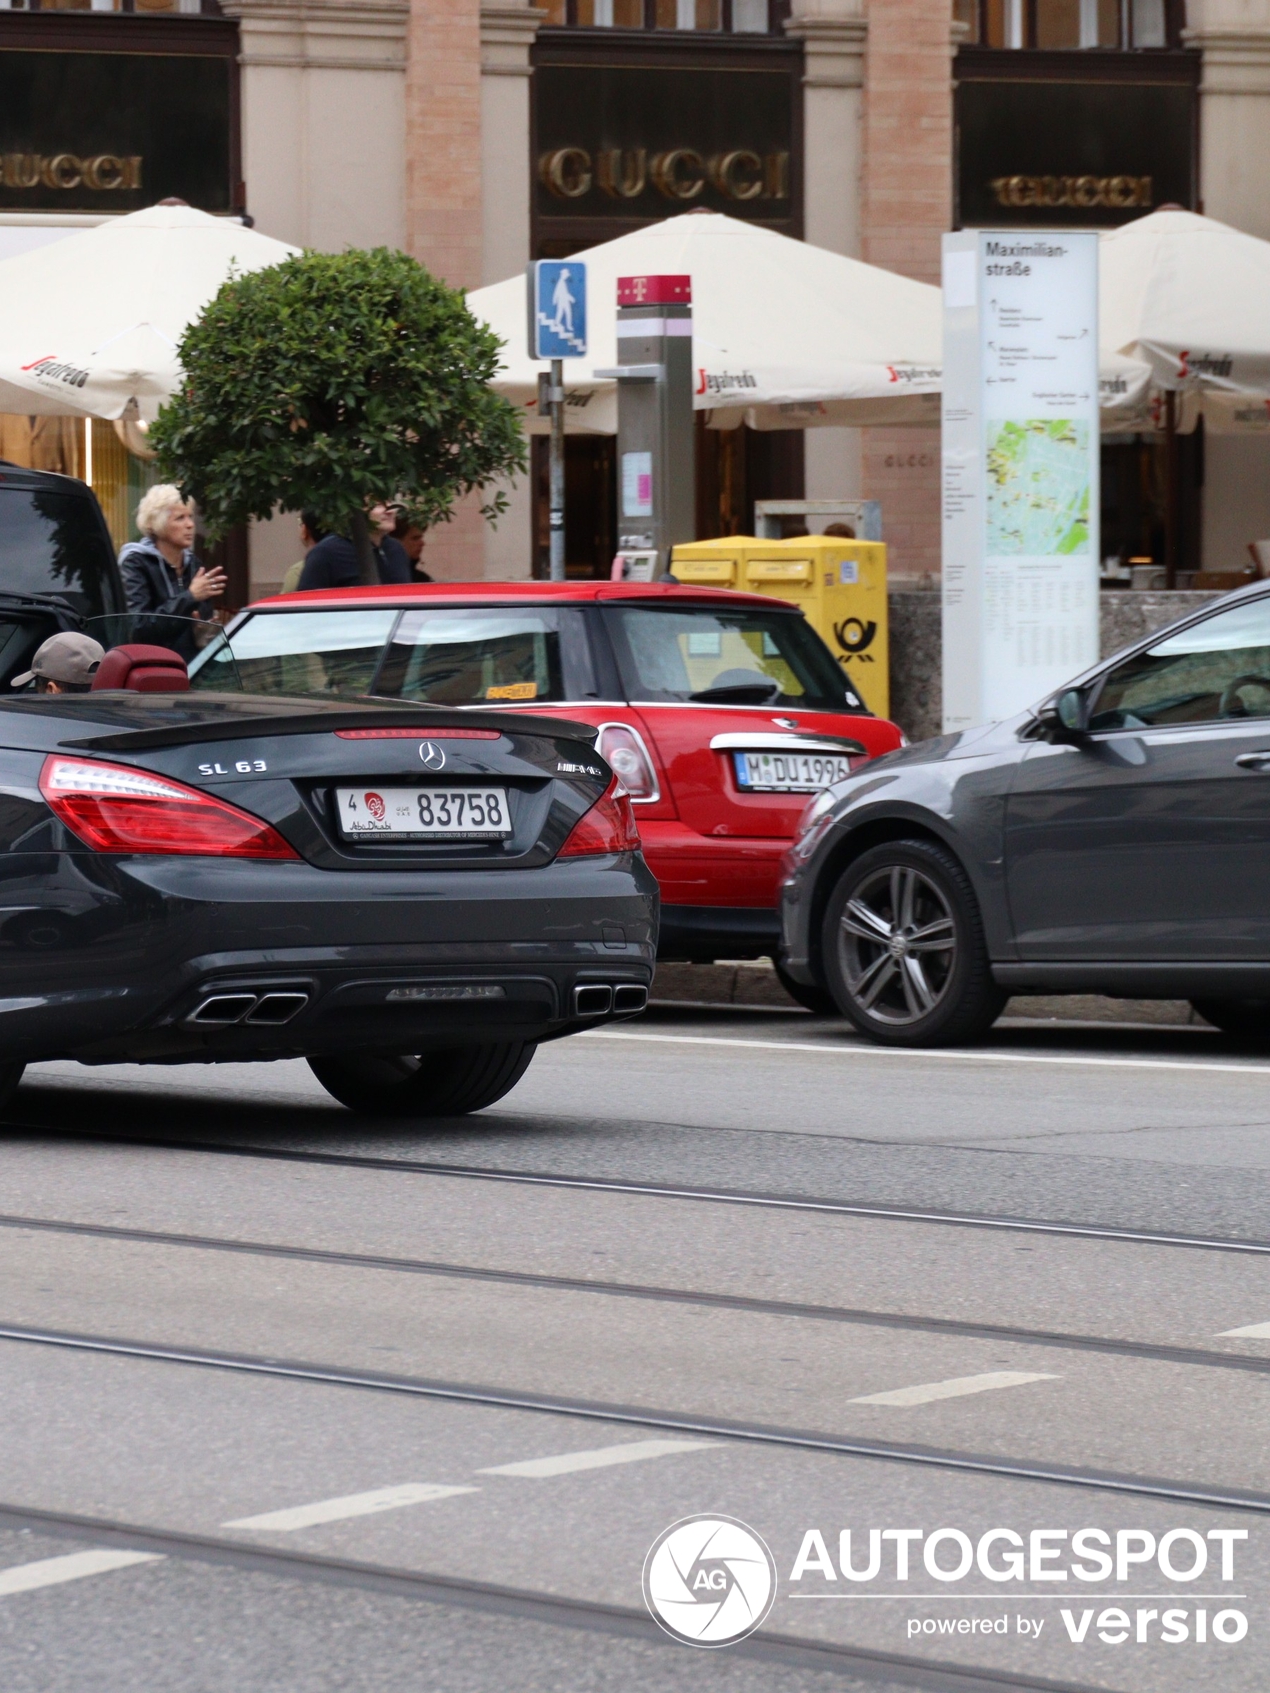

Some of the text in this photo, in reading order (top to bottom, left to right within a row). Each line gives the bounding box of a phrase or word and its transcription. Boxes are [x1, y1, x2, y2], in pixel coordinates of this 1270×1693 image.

[538, 147, 788, 199] GUCCI
[994, 175, 1151, 207] GUCCI
[986, 242, 1068, 257] Maximilian-
[986, 261, 1031, 276] straße
[20, 355, 90, 389] Segafredo
[198, 760, 267, 776] SL 63
[747, 757, 848, 784] M DU 1996
[348, 794, 357, 811] 4
[417, 793, 503, 826] 83758
